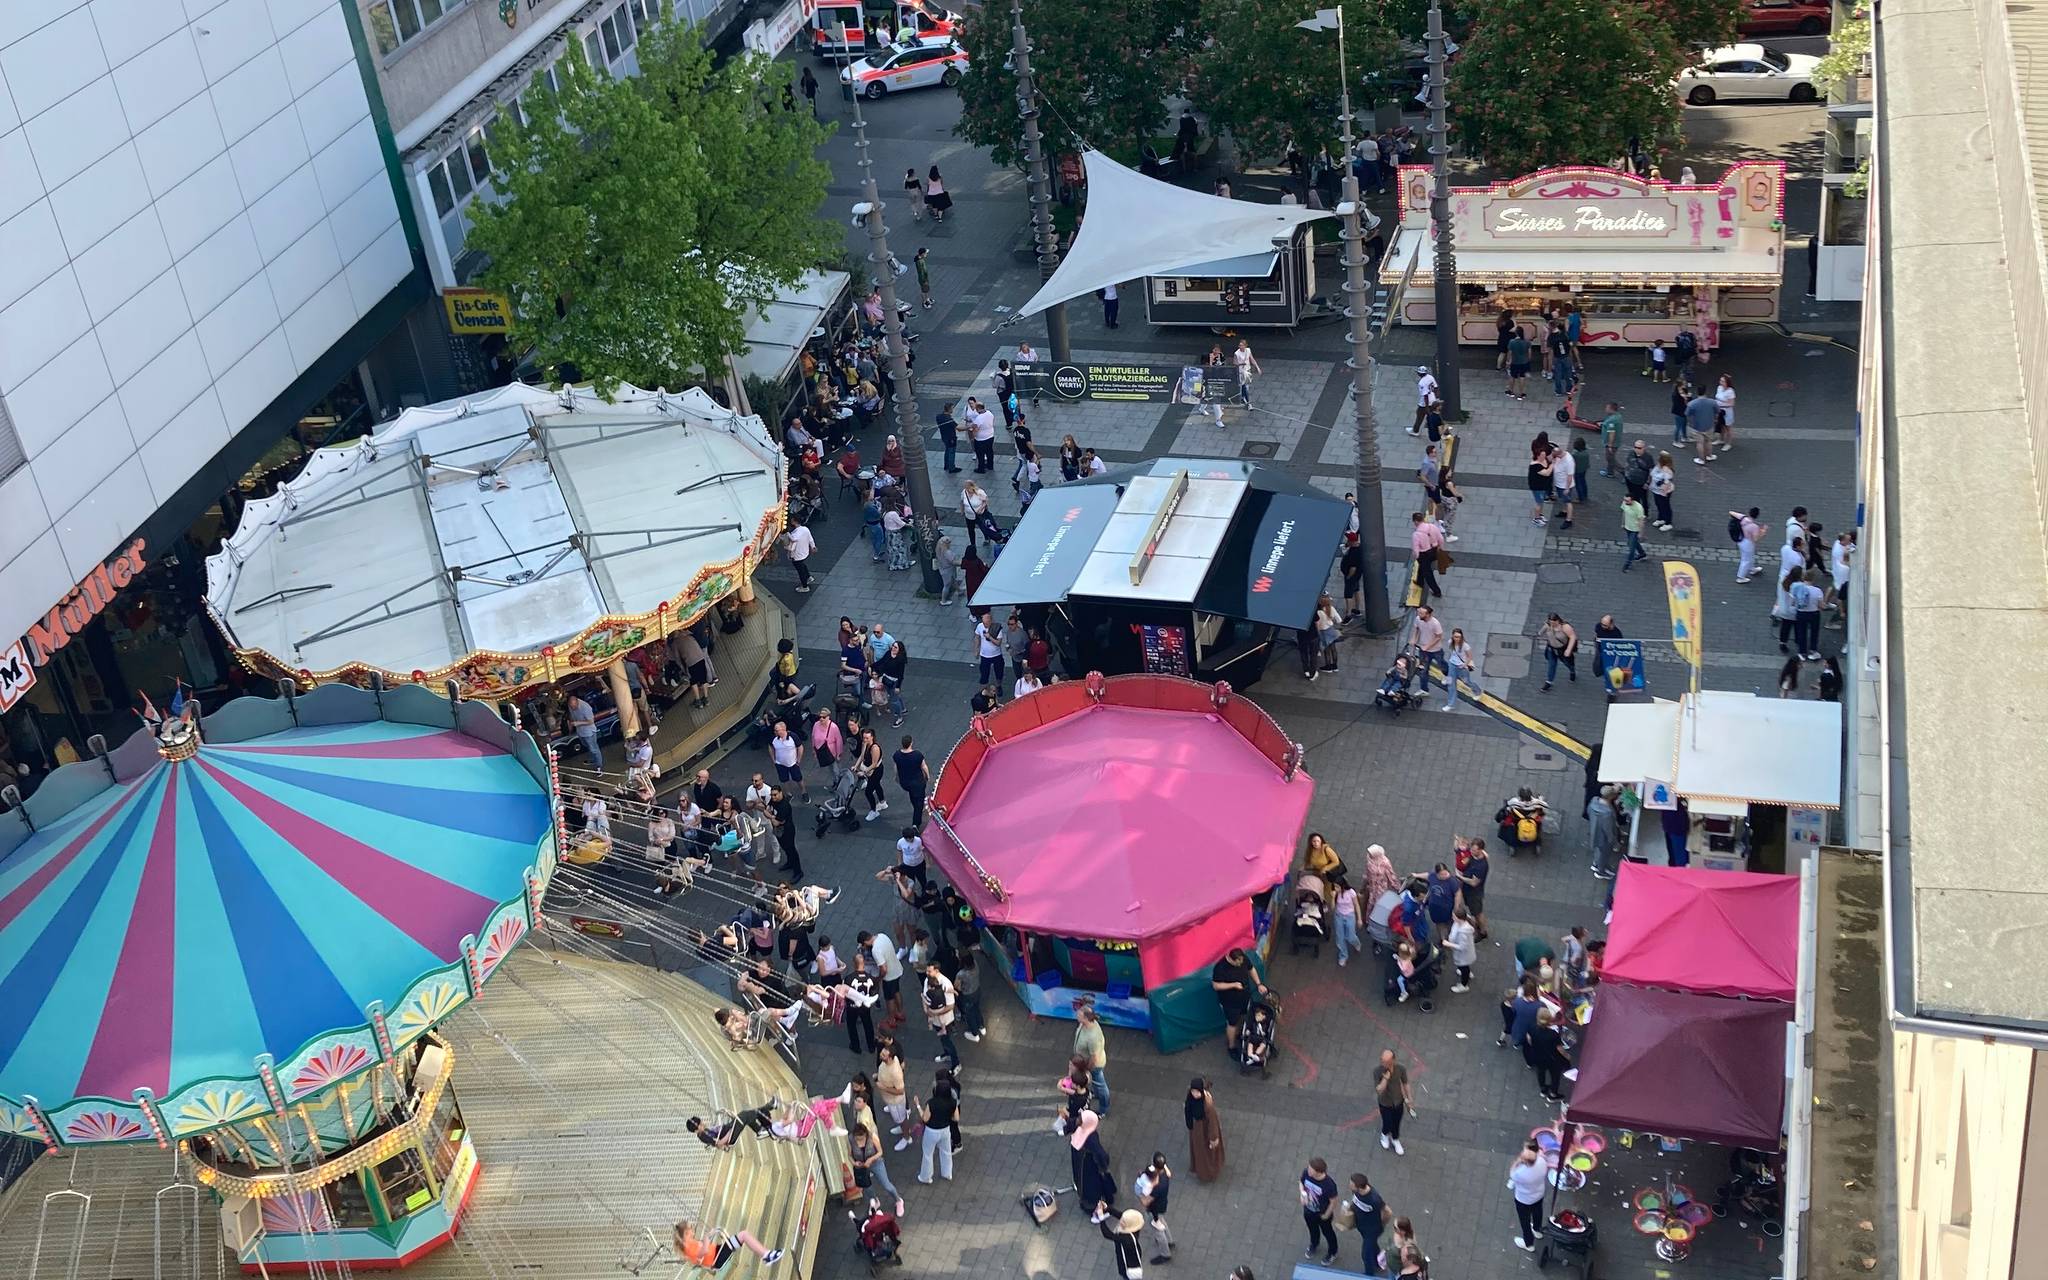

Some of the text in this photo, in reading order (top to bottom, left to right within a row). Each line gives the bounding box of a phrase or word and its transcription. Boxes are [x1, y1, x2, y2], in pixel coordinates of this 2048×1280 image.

[1574, 206, 1667, 232] Paradies
[1088, 366, 1150, 374] EIN VIRTUELLER
[1088, 374, 1168, 383] STADTSPAZIERGANG
[1261, 546, 1285, 574] linnepe
[27, 538, 146, 668] Müller
